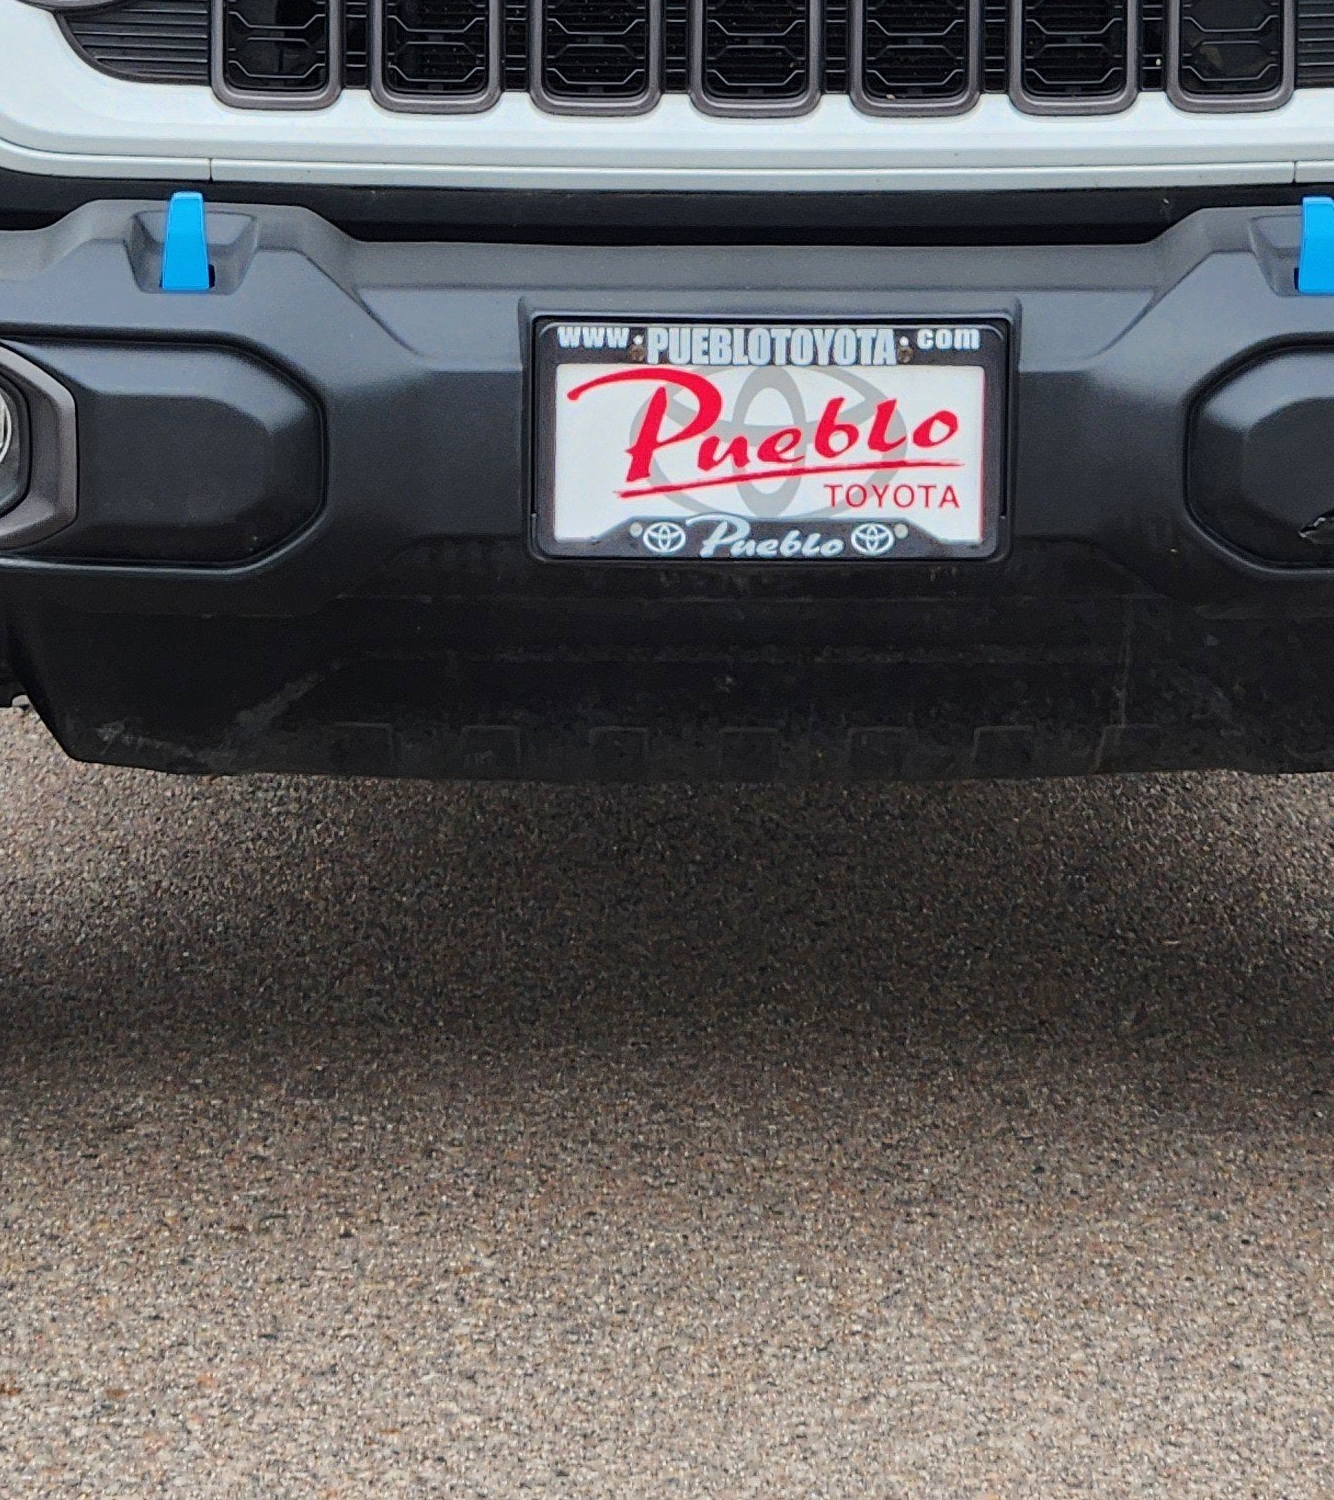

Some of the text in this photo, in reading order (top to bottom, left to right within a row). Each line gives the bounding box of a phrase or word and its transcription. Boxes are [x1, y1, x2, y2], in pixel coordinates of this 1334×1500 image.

[566, 366, 960, 483] Pueblo
[823, 483, 960, 509] TOYOTA
[685, 512, 845, 558] Pueblo
